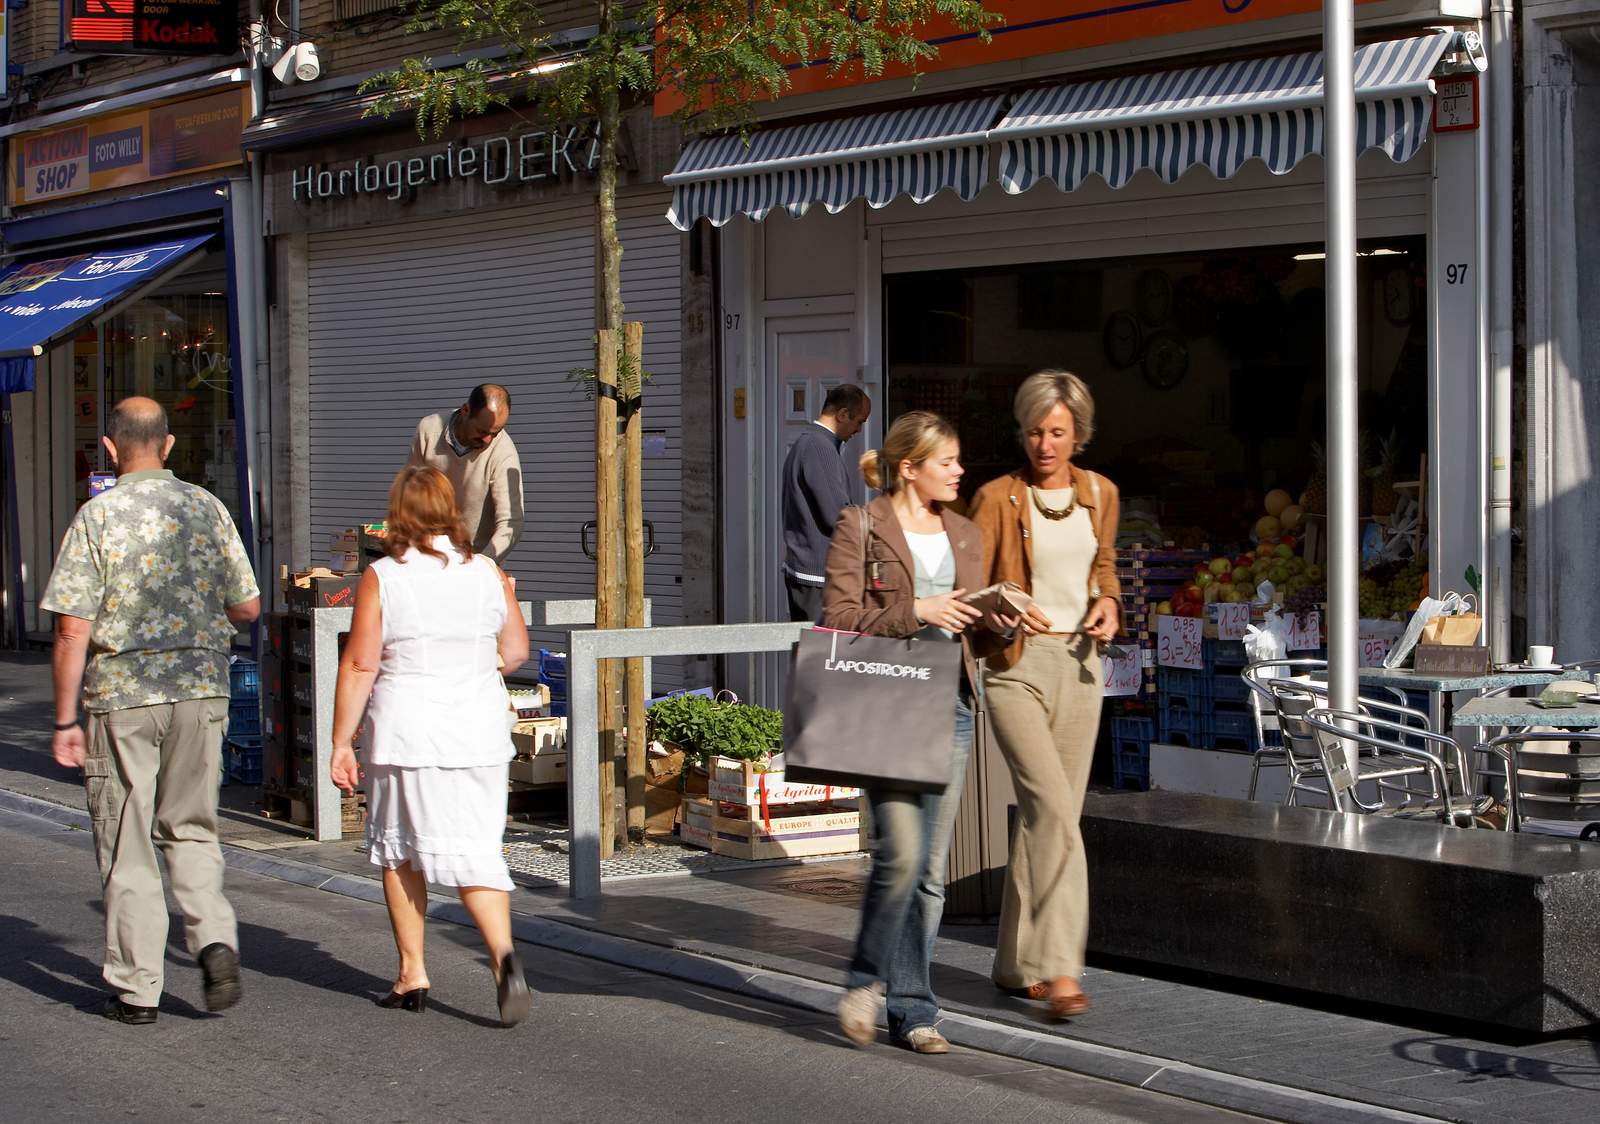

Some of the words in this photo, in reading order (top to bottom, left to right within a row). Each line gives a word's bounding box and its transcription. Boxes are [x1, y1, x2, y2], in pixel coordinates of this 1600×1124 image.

[143, 20, 218, 44] Kodak
[28, 127, 84, 164] ACTION
[95, 144, 116, 163] FOTO
[118, 136, 141, 158] WILLY
[35, 162, 78, 194] SHOP
[293, 142, 477, 200] Horlogerie
[1446, 263, 1468, 285] 97
[726, 313, 741, 330] 97
[779, 820, 812, 830] EUROPE
